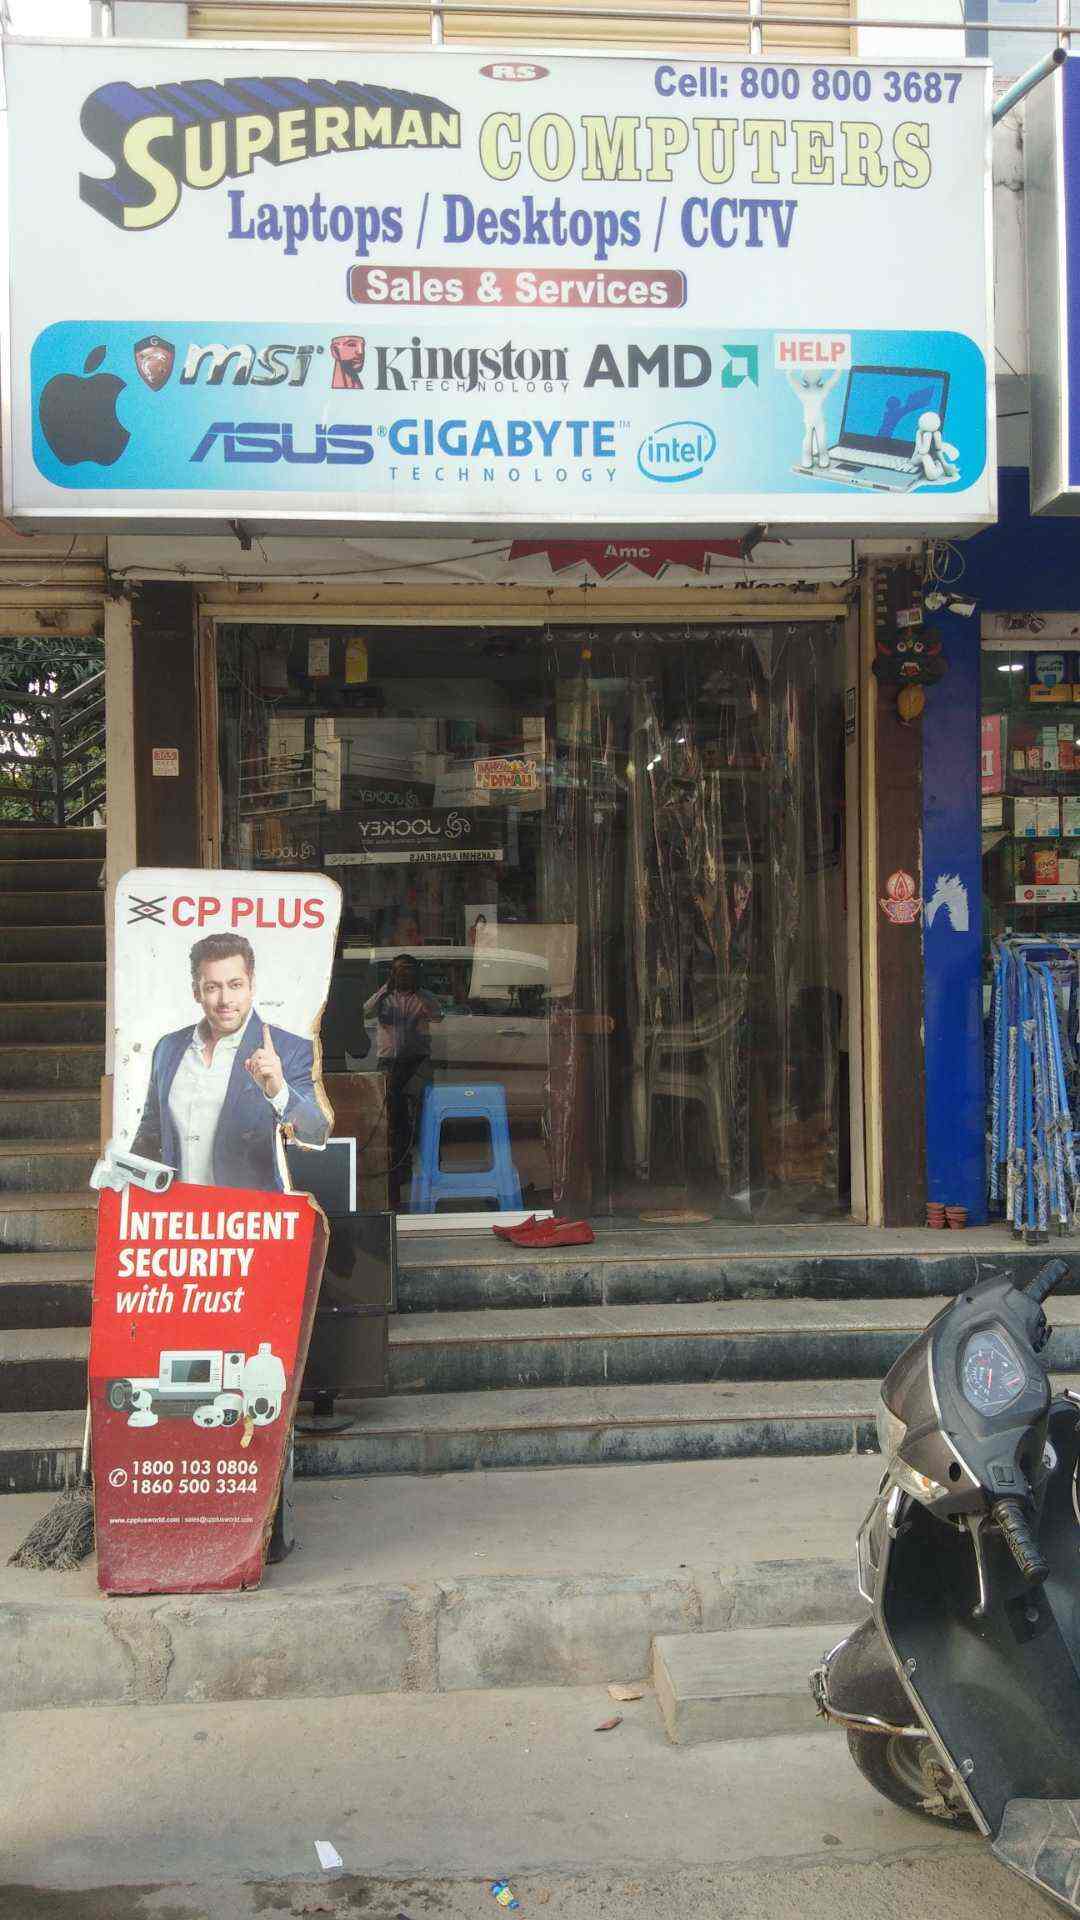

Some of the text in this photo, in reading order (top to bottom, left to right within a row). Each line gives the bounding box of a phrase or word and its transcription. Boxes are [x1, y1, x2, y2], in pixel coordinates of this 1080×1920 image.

[492, 65, 536, 79] RS
[654, 66, 962, 103] Cell: 800 800 3687
[100, 90, 932, 231] SUPERMAN COMPUTERS
[228, 190, 402, 256] Laptops
[443, 194, 641, 261] Desktops
[681, 197, 798, 248] CCTV
[367, 269, 669, 305] Sales & Services
[374, 336, 568, 393] Kingston
[584, 344, 713, 389] AMD
[779, 341, 846, 363] HELP
[410, 381, 569, 393] TECHNOLOGY
[189, 422, 374, 465] ASUS
[388, 419, 616, 457] GIGABYTE
[648, 435, 702, 463] intel
[389, 466, 616, 482] TECHNOLOGY
[603, 544, 651, 558] Amc
[172, 896, 325, 928] CP PLUS
[119, 1182, 299, 1240] INTELLIGENT
[118, 1248, 254, 1278] SECURITY
[115, 1283, 245, 1314] with Trust
[132, 1460, 258, 1475] 1800 103 0806
[131, 1479, 257, 1494] 1860 500 3344
